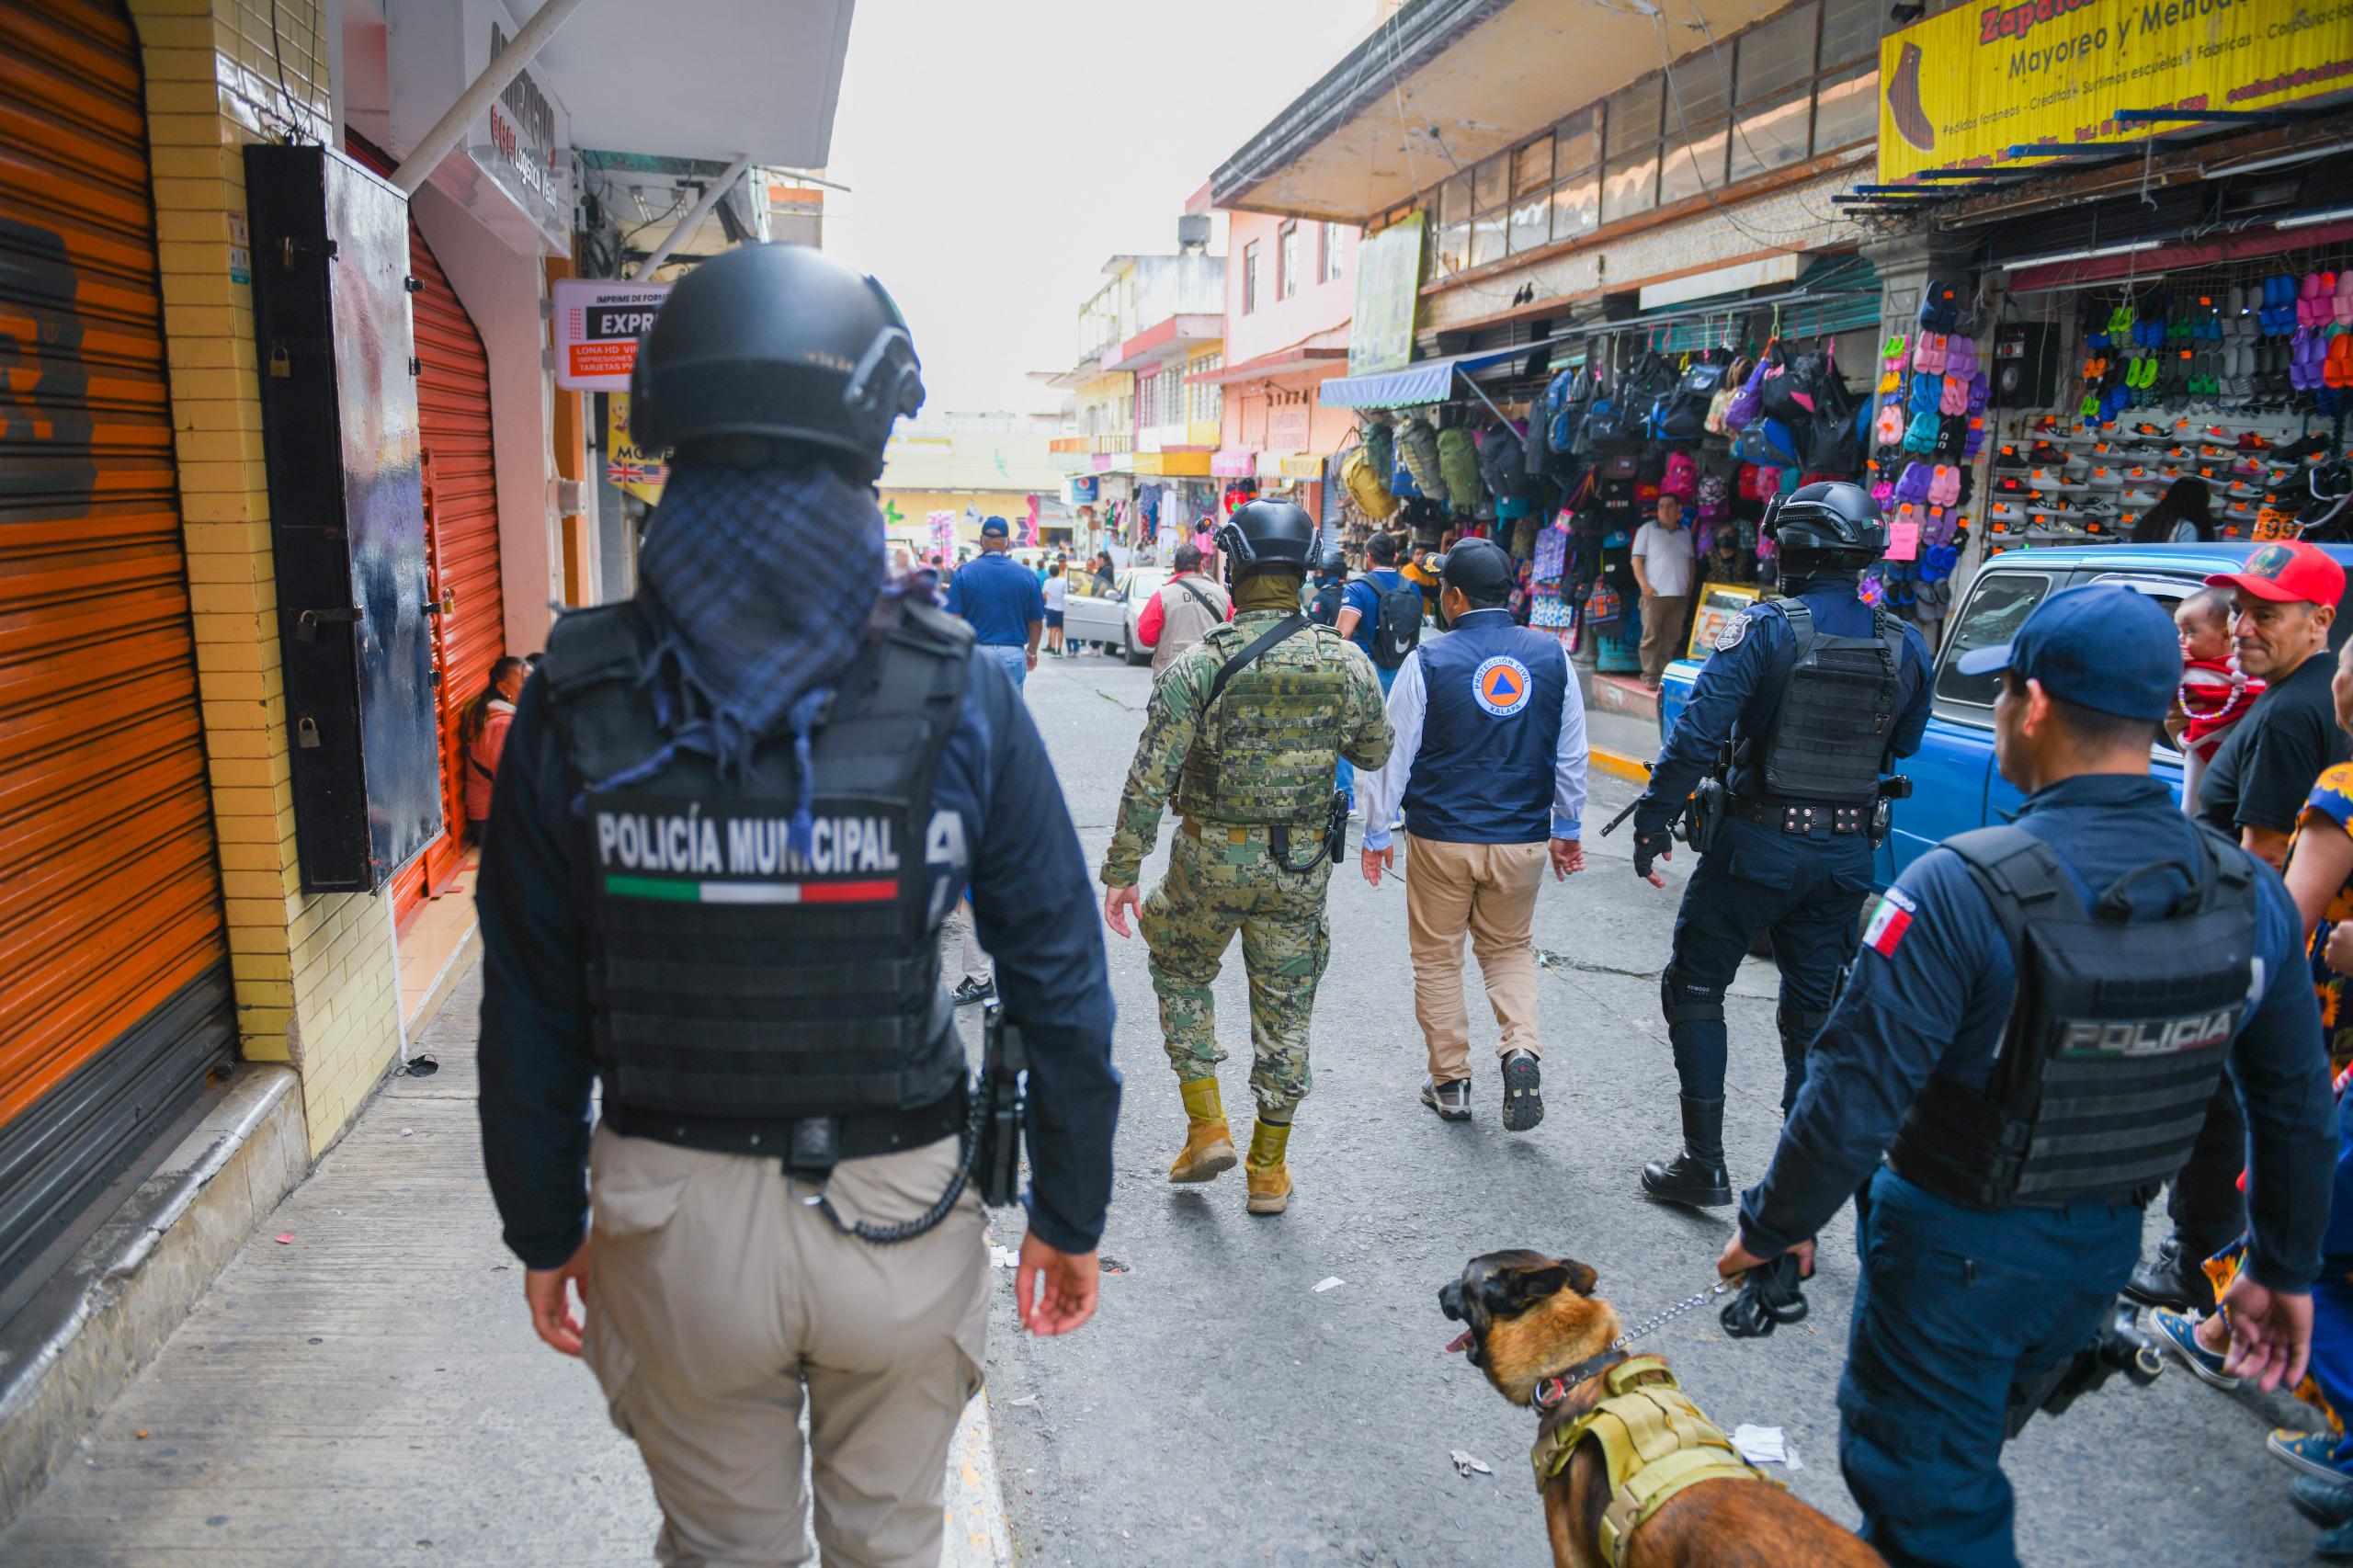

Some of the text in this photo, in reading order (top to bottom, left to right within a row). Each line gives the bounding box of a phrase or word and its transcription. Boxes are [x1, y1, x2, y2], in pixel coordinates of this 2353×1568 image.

[2008, 0, 2248, 80] Mayoreo y Menu
[596, 294, 630, 304] IMPRIME
[631, 294, 642, 302] DE
[601, 312, 658, 335] EXPR
[576, 346, 603, 355] LONA
[604, 346, 620, 354] HD
[577, 355, 633, 363] IMPRESIONES
[579, 362, 620, 372] TARJETAS
[1516, 664, 1529, 685] CIVIL
[1489, 704, 1522, 715] XALAPA
[596, 801, 723, 873] POLICÍA
